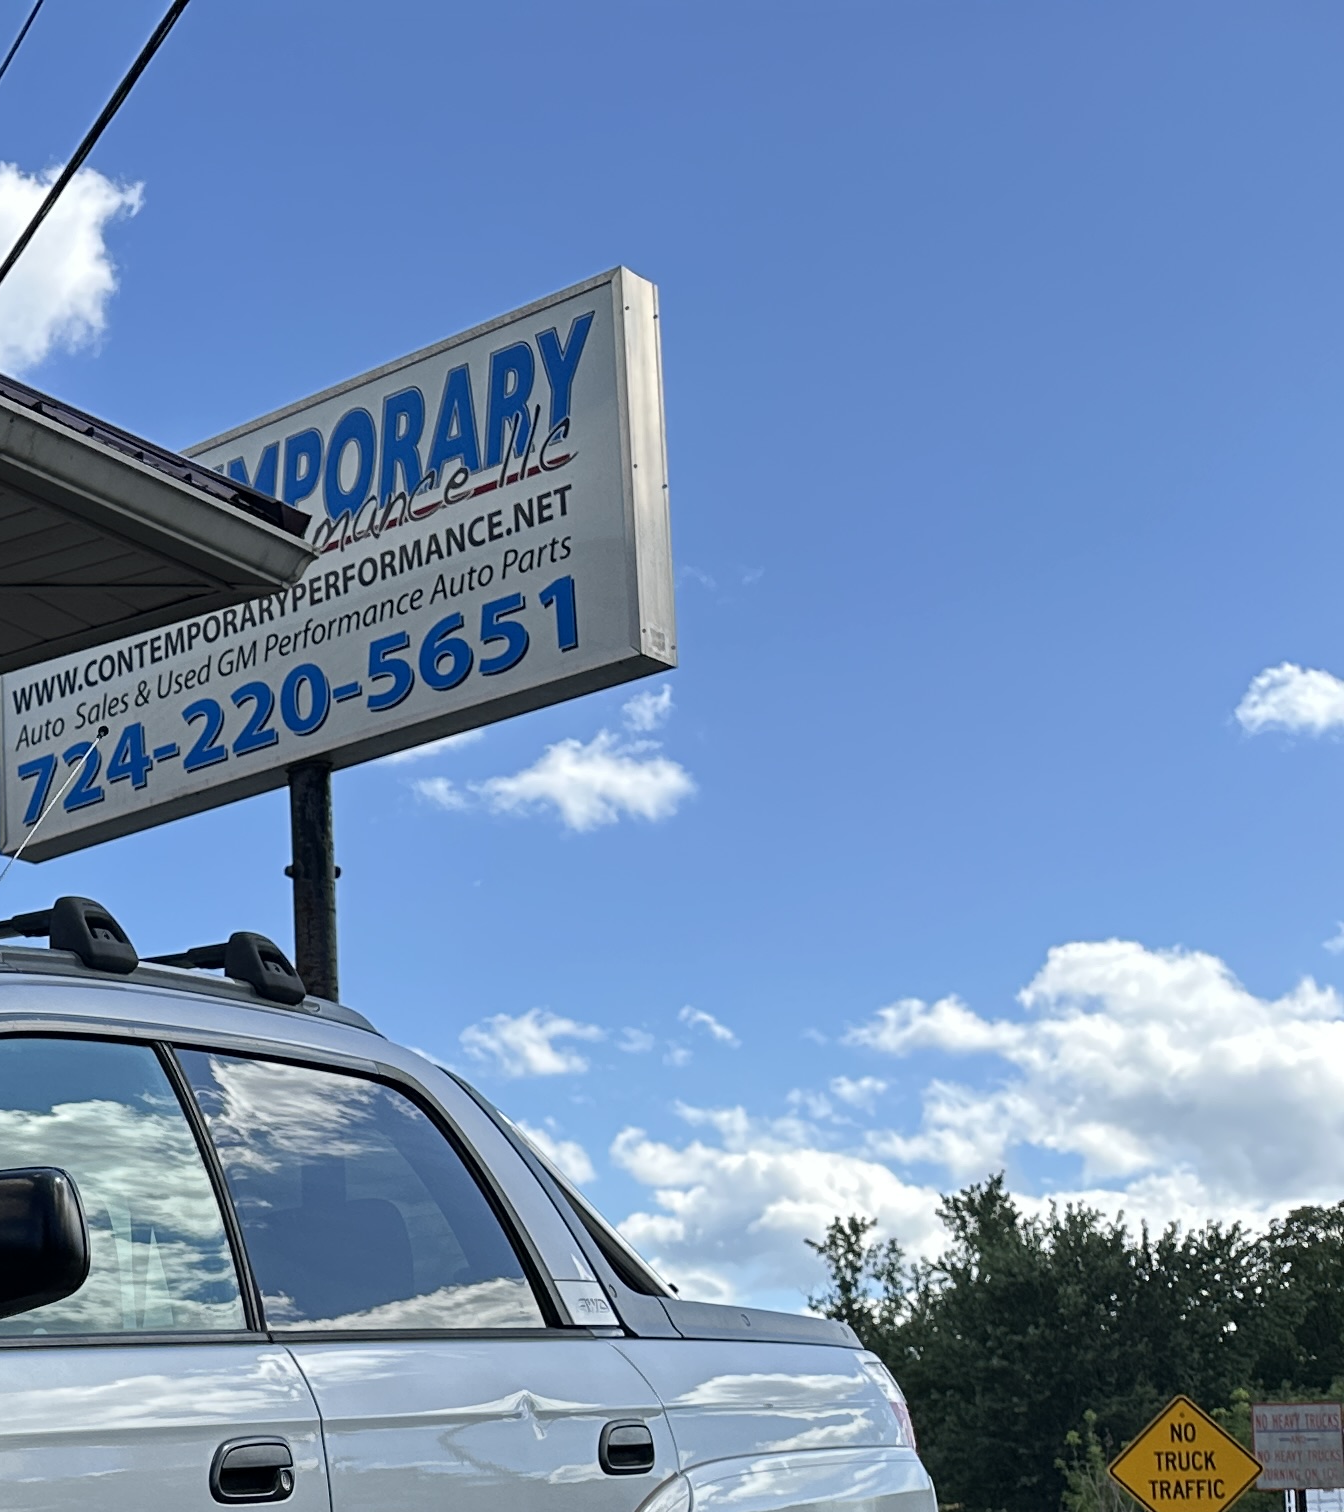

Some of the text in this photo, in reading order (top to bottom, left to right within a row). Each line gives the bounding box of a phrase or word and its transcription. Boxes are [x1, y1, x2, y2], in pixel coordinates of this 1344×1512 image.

[214, 311, 595, 523] MPORARY
[12, 484, 572, 715] WWW.CONTEMPORARYPERFORMANCE.NET
[15, 535, 573, 752] Auto Sales & Used GM Performance Auto Parts
[17, 575, 579, 826] 724-220-5651
[1153, 1450, 1217, 1472] TRUCK
[1170, 1422, 1196, 1443] NO
[1255, 1412, 1340, 1430] NO HEAVY TRUCKS
[1148, 1479, 1226, 1500] TRAFFIC
